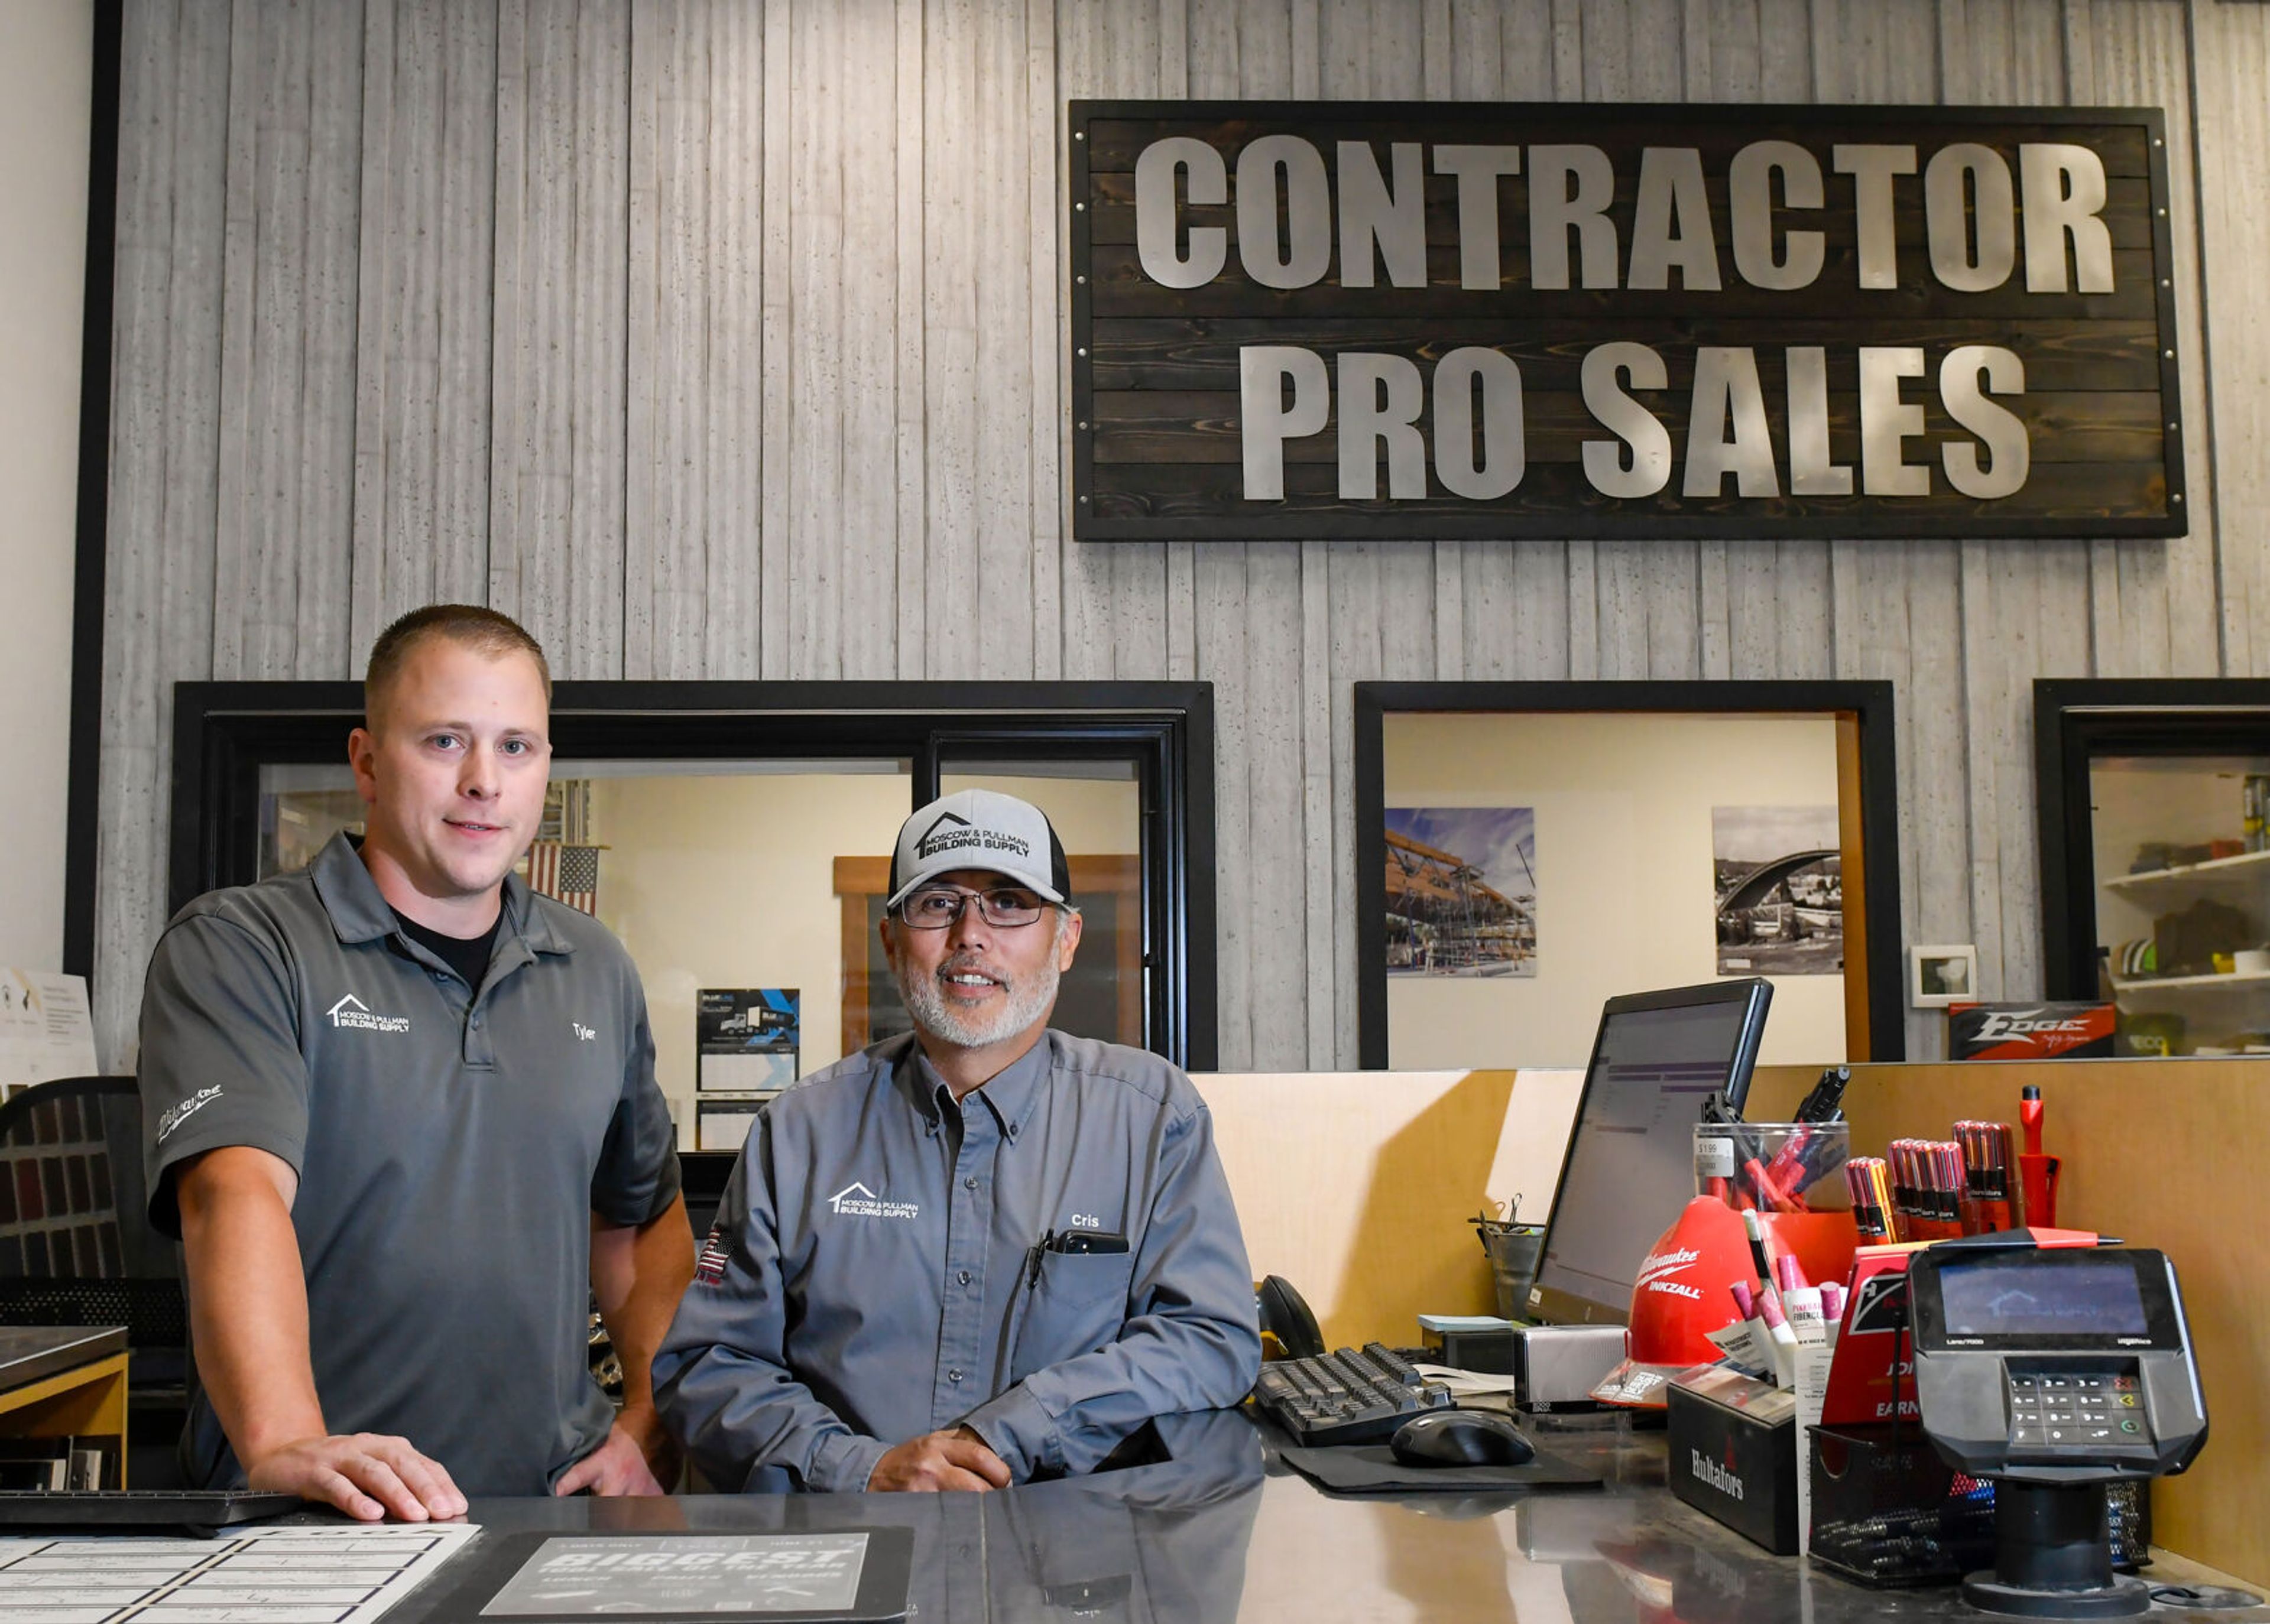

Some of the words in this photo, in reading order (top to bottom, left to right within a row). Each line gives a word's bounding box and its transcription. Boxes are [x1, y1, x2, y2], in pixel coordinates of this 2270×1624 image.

[1134, 134, 2115, 294] CONTRACTOR
[1239, 345, 1525, 501] PRO
[1580, 341, 2030, 500] SALES
[926, 829, 971, 845] MOSCOW
[982, 830, 1029, 848] PULLMAN
[926, 838, 981, 857] BUILDING
[984, 839, 1029, 858] SUPPLY
[341, 1018, 378, 1030] BUILDING
[379, 1022, 409, 1032] SUPPLY
[376, 1015, 409, 1025] PULLMAN
[1969, 1008, 2092, 1045] EDGE
[572, 1022, 596, 1041] Tyler
[840, 1206, 881, 1217] BUILDING
[883, 1209, 917, 1219] SUPPLY
[841, 1200, 875, 1209] MOSCOW
[883, 1202, 918, 1211] PULLMAN
[1072, 1214, 1099, 1227] Cris
[1648, 1281, 1701, 1300] INKZALL
[1691, 1448, 1743, 1500] Hultafors
[542, 1550, 855, 1567] BIGGEST
